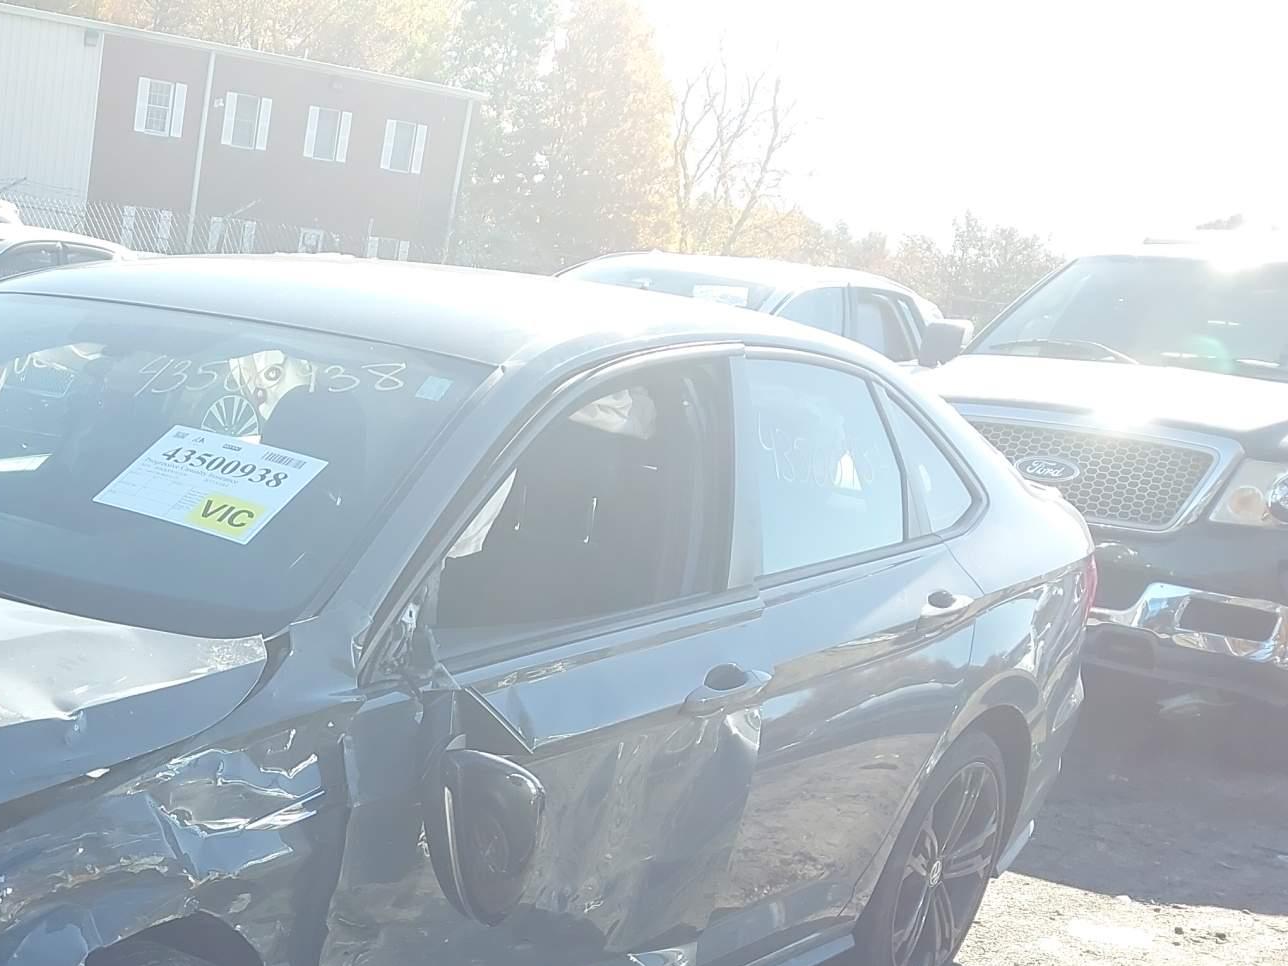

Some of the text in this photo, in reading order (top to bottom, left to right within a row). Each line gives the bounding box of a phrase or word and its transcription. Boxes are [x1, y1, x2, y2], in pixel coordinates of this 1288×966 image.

[162, 446, 289, 488] 43500938
[1026, 460, 1065, 477] Ford
[201, 499, 255, 527] VIC
